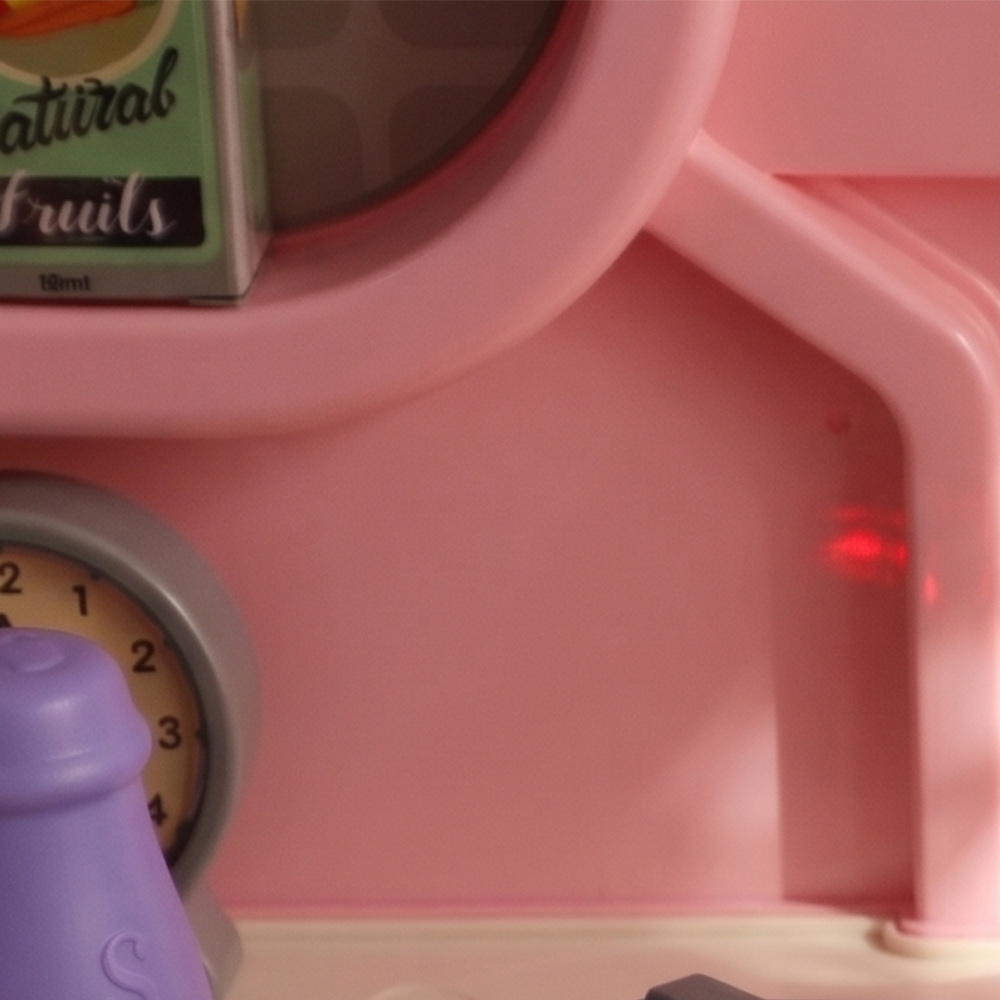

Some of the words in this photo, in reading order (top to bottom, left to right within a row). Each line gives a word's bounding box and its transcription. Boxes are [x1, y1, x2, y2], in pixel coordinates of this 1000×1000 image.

[72, 584, 88, 616] 1
[131, 639, 157, 673] 2
[158, 716, 182, 750] 3
[147, 792, 168, 827] 4
